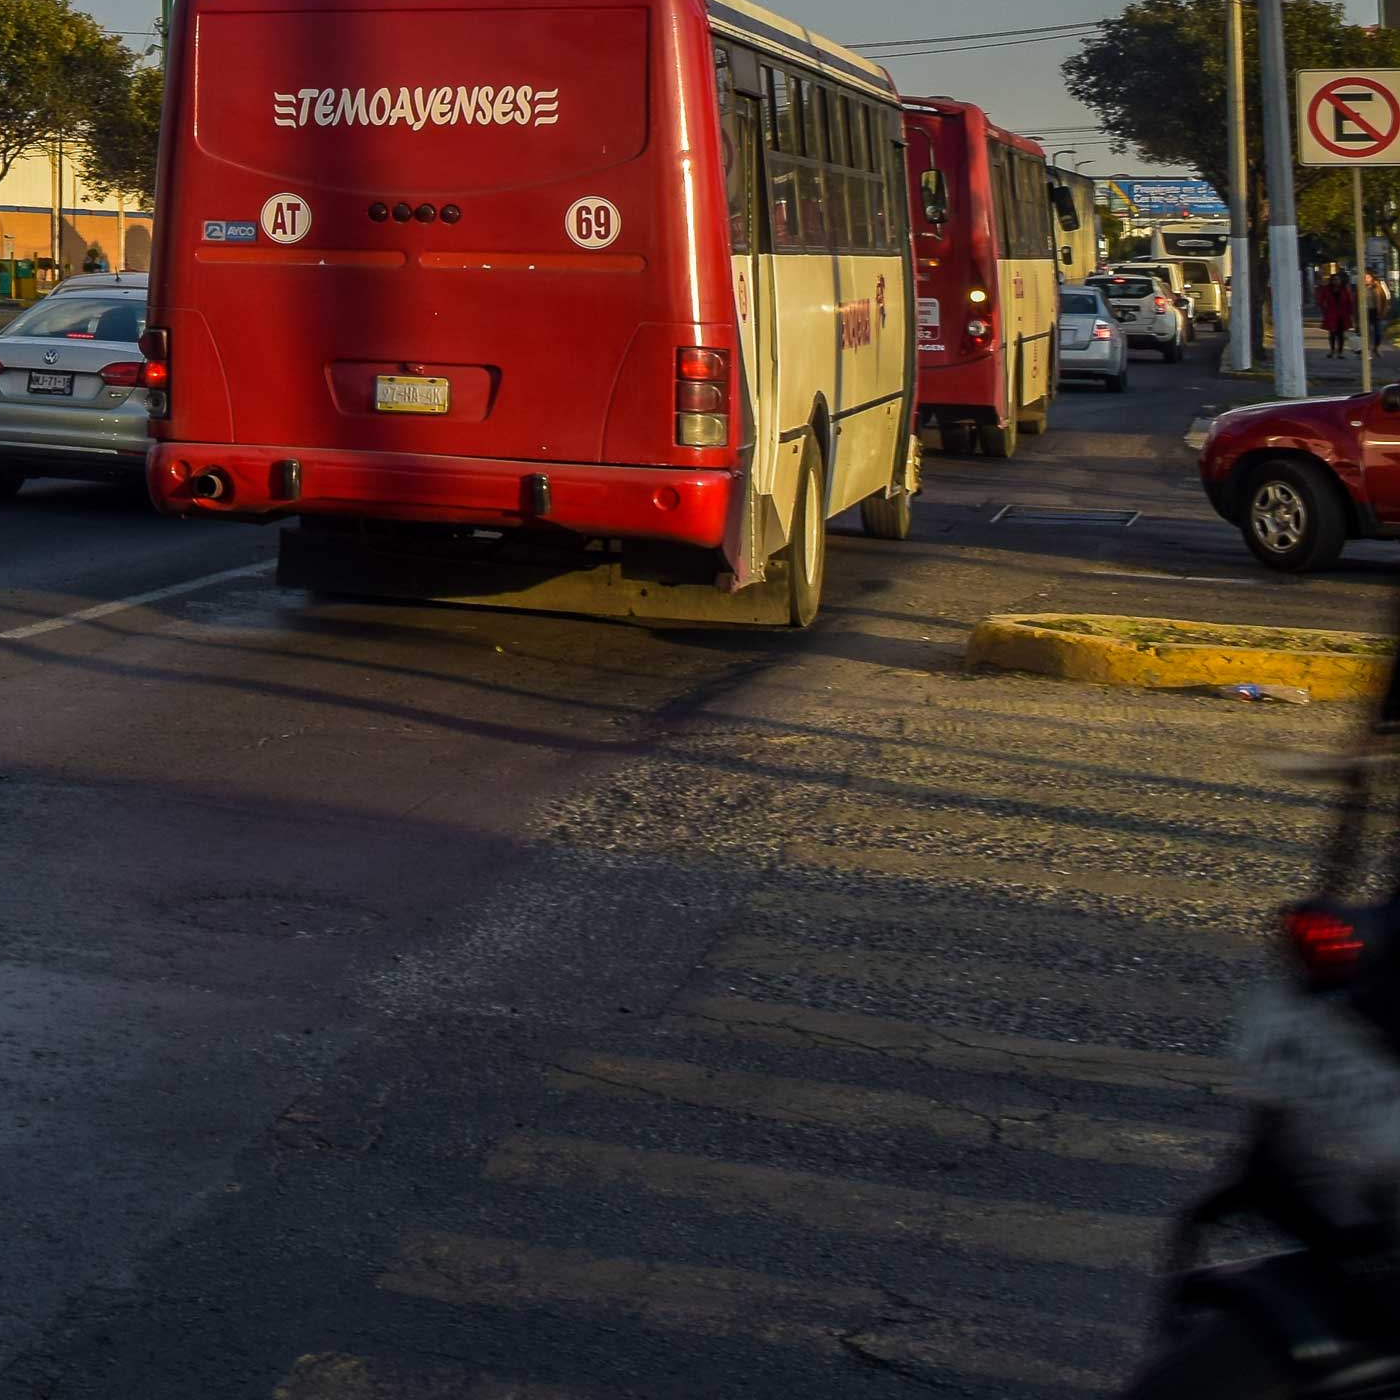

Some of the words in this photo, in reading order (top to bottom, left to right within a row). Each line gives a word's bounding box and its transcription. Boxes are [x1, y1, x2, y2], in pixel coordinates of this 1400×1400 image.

[297, 85, 533, 131] TEMOAYENSES
[271, 202, 301, 235] AT
[576, 205, 611, 240] 69
